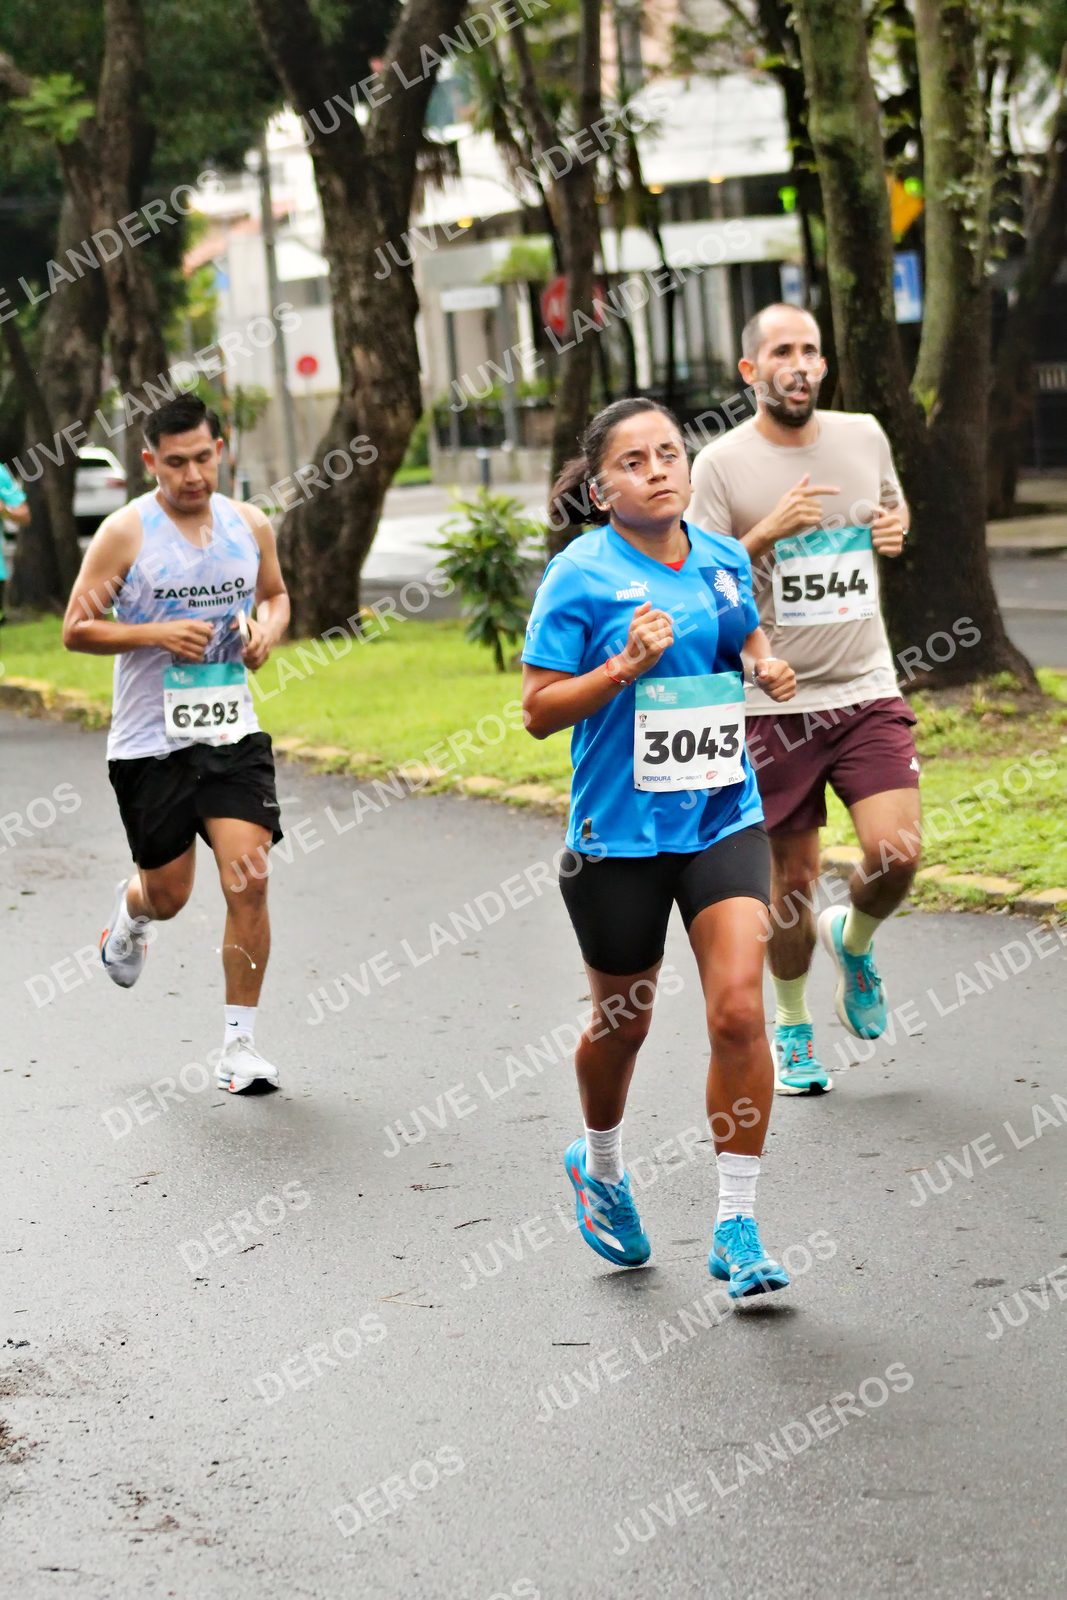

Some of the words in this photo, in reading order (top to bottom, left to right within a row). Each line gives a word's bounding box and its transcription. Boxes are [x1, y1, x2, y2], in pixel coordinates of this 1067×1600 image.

[153, 577, 245, 600] ZACOALCO
[616, 588, 646, 600] PUMA
[782, 569, 868, 603] 5544
[172, 700, 239, 729] 6293
[642, 723, 740, 766] 3043
